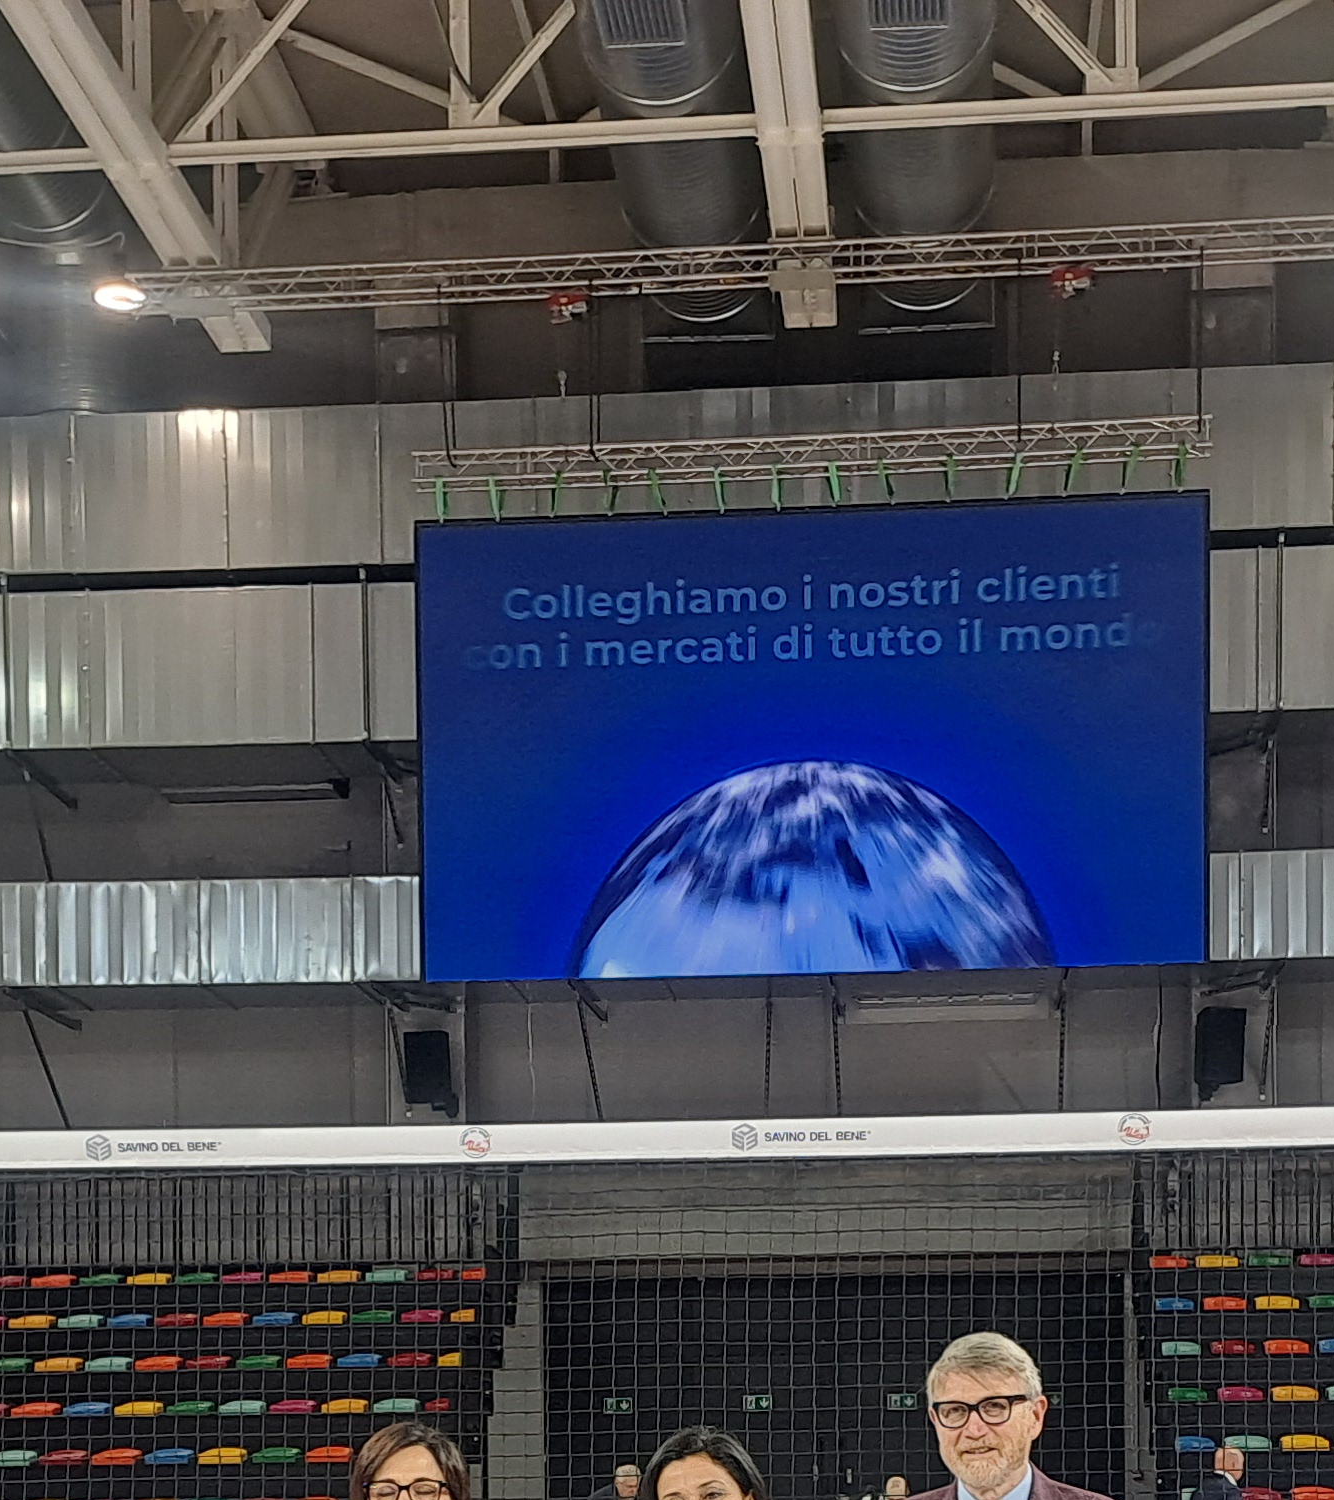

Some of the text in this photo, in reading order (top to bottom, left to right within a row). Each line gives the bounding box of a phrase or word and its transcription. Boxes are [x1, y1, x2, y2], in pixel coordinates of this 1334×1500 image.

[503, 561, 1121, 625] Colleghiamo i nostri clienti
[467, 637, 542, 672] con
[557, 632, 569, 668] i
[585, 626, 758, 668] mercati
[773, 623, 815, 660] di
[829, 622, 943, 660] tutto
[958, 616, 981, 654] il
[117, 1141, 219, 1153] SAVINO DEL BENE
[764, 1131, 867, 1142] SAVINO DEL BENE
